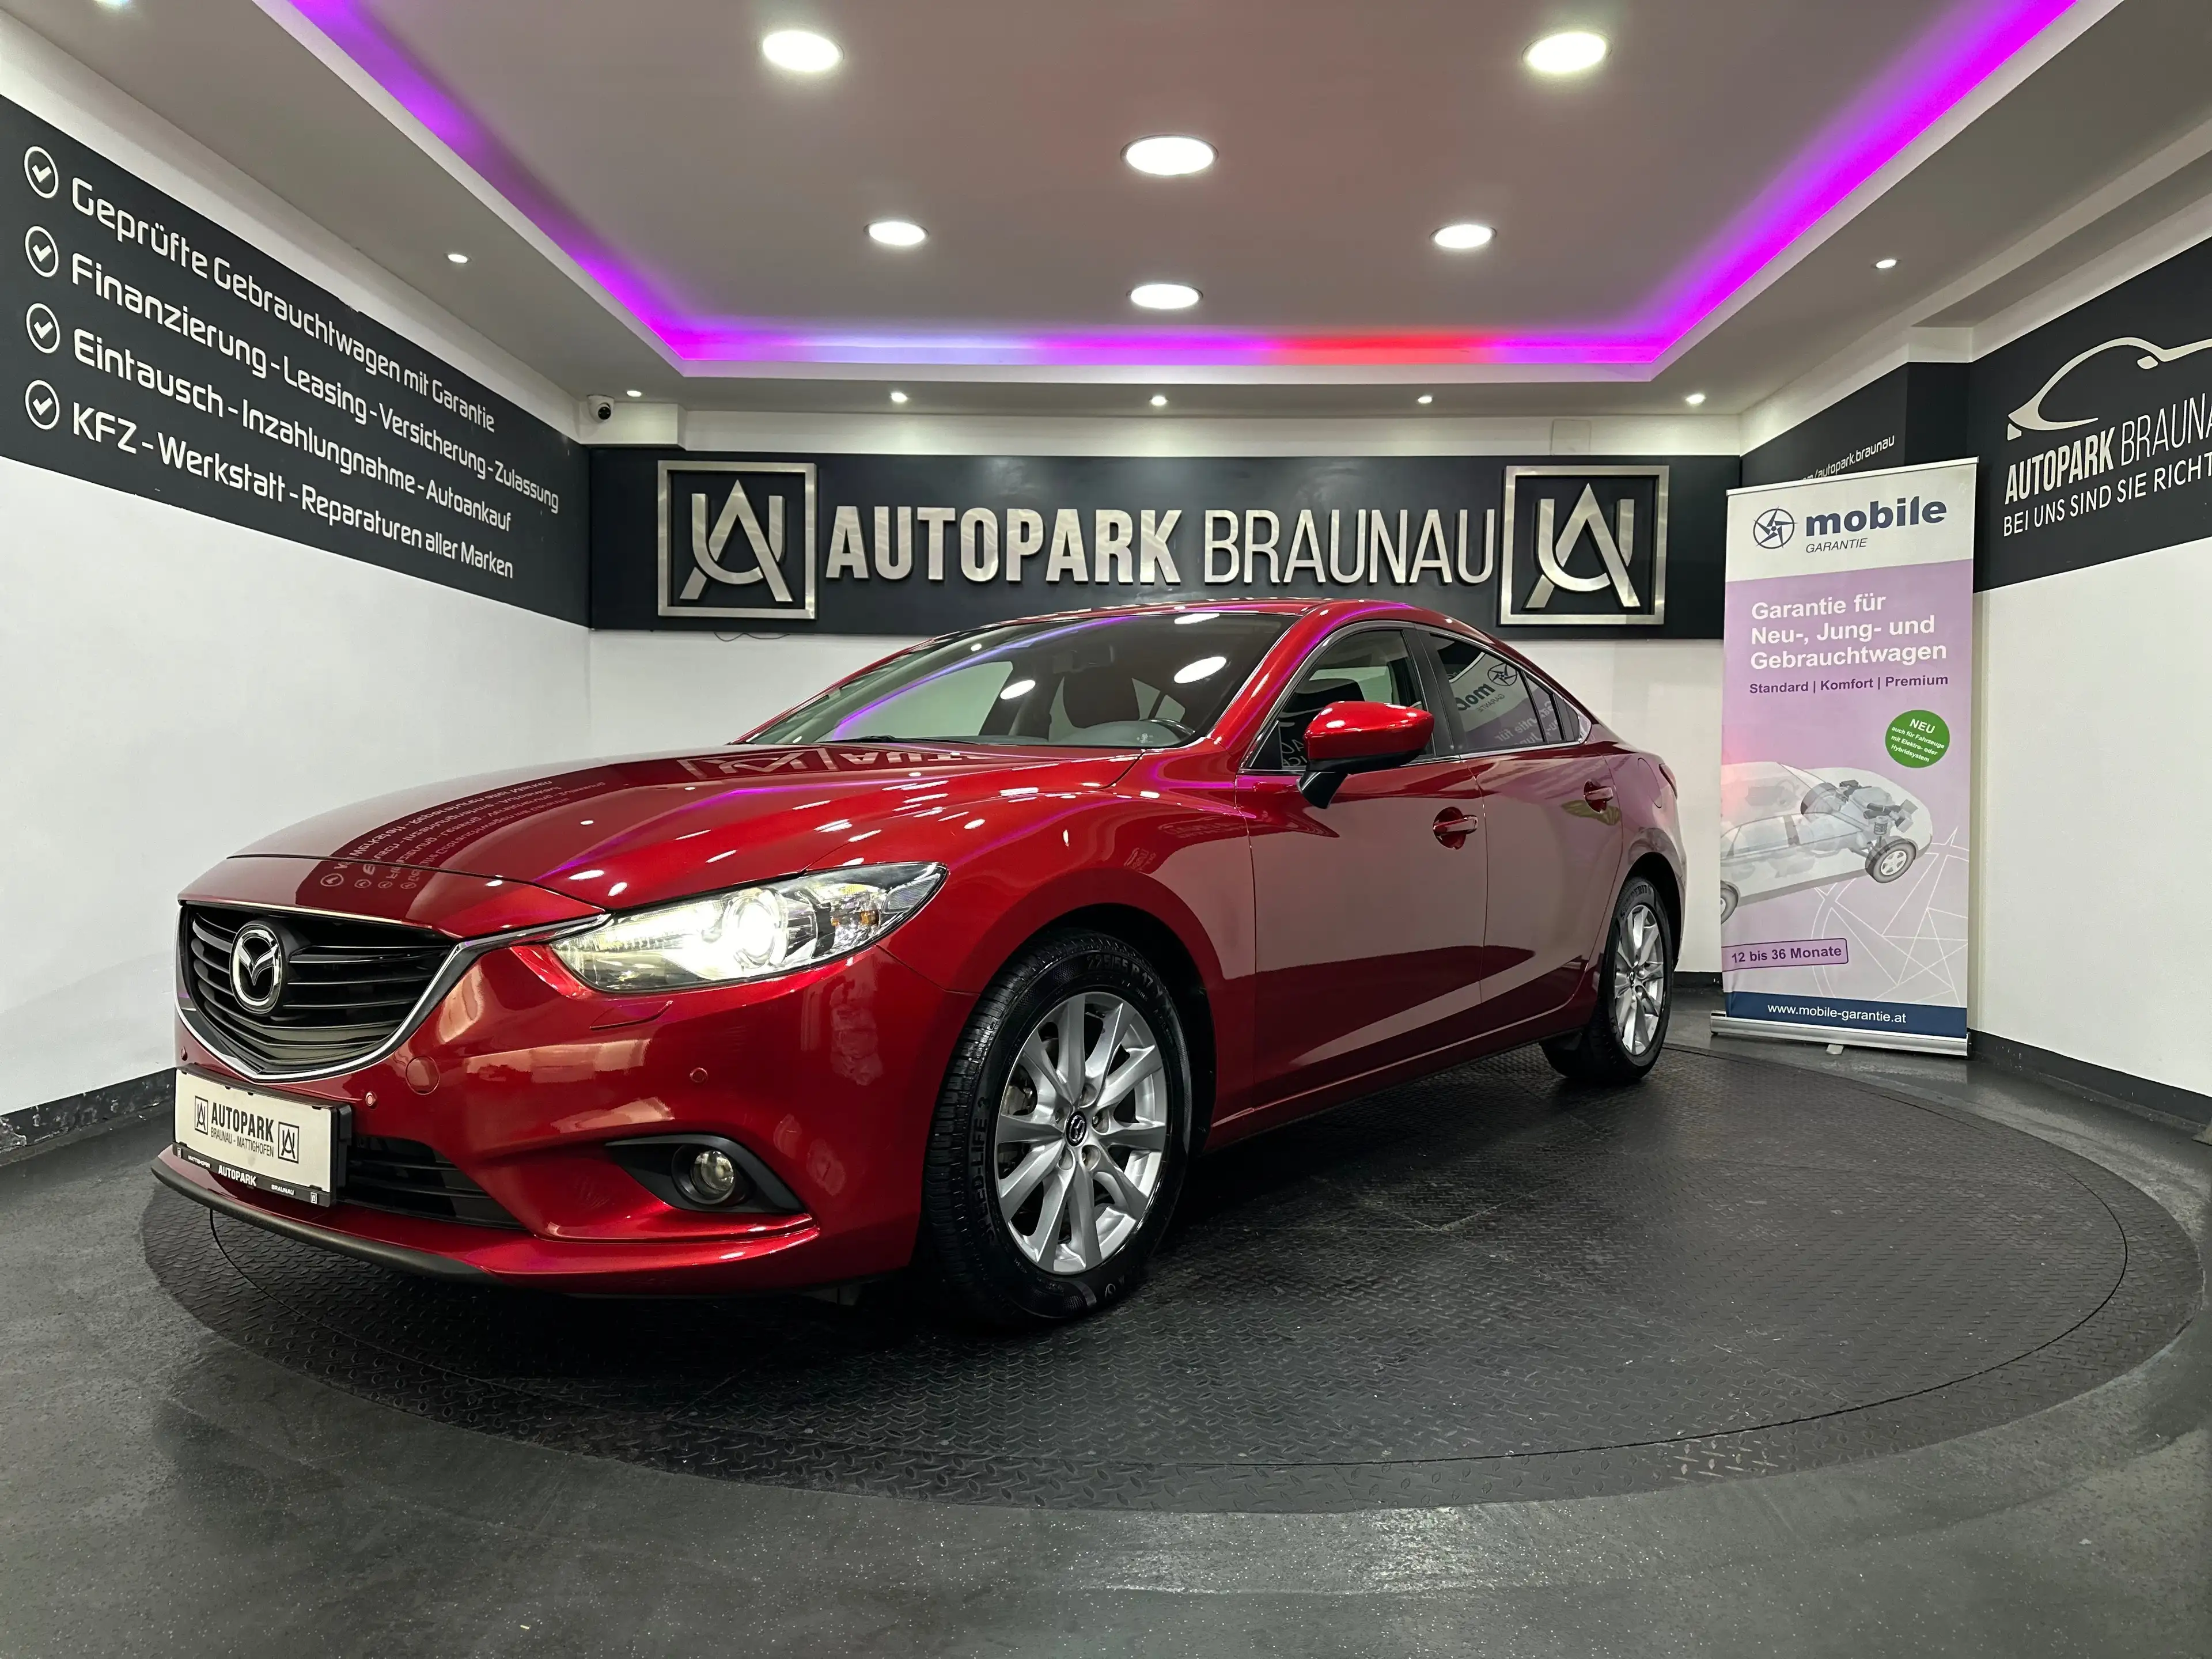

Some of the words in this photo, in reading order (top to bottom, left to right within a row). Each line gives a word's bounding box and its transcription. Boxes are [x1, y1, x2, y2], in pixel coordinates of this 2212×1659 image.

[72, 177, 207, 279] Geprüfte
[214, 257, 399, 382] Gebrauchtwagen
[404, 369, 429, 396] mit
[432, 380, 494, 433] Garantie
[72, 253, 267, 378] Finanzierung
[285, 355, 366, 425] Leasing
[379, 403, 486, 479] Versicherung
[495, 461, 558, 514] Zulassung
[74, 328, 223, 417] Eintausch
[243, 399, 415, 494] Inzahlungnahme
[426, 479, 512, 532] Autoankauf
[2005, 426, 2115, 505] AUTOPARK
[73, 402, 137, 454] KFZ
[158, 432, 286, 502] Werkstatt
[302, 484, 422, 548] Reparaturen
[425, 532, 458, 559] aller
[461, 541, 513, 578] Marken
[1805, 496, 1947, 537] mobile
[2003, 510, 2028, 537] BEI
[2034, 499, 2065, 528] UNS
[2070, 485, 2111, 517] SIND
[2116, 472, 2147, 503] SIE
[826, 505, 1182, 585] AUTOPARK
[1205, 509, 1496, 585] BRAUNAU
[1805, 537, 1868, 554] GARANTIE
[1751, 597, 1846, 620] Garantie
[1853, 593, 1887, 612] für
[1751, 627, 1809, 645] Neu-,
[1816, 623, 1882, 642] Jung-
[1889, 615, 1935, 635] und
[1750, 644, 1947, 670] Gebrauchtwagen
[1749, 681, 1809, 694] Standard
[1820, 677, 1874, 691] Komfort
[1885, 675, 1949, 687] Premium
[1891, 726, 1906, 734] auch
[1915, 734, 1945, 749] Fahrzeuge
[1909, 718, 1936, 733] NEU
[1891, 744, 1930, 762] Hybridsystem
[1901, 738, 1923, 749] Elektro-
[1924, 748, 1938, 756] oder
[1732, 952, 1745, 964] 12
[1749, 949, 1767, 962] bis
[1771, 948, 1786, 961] 36
[1790, 945, 1842, 959] Monate
[1767, 1004, 1907, 1024] www.mobile-garantie.at
[211, 1102, 274, 1143] AUTOPARK
[210, 1127, 233, 1143] BRAUNAU
[237, 1137, 274, 1158] MATTIGHOFEN
[218, 1165, 257, 1187] AUTOPARK
[271, 1184, 295, 1196] BRAUNAU
